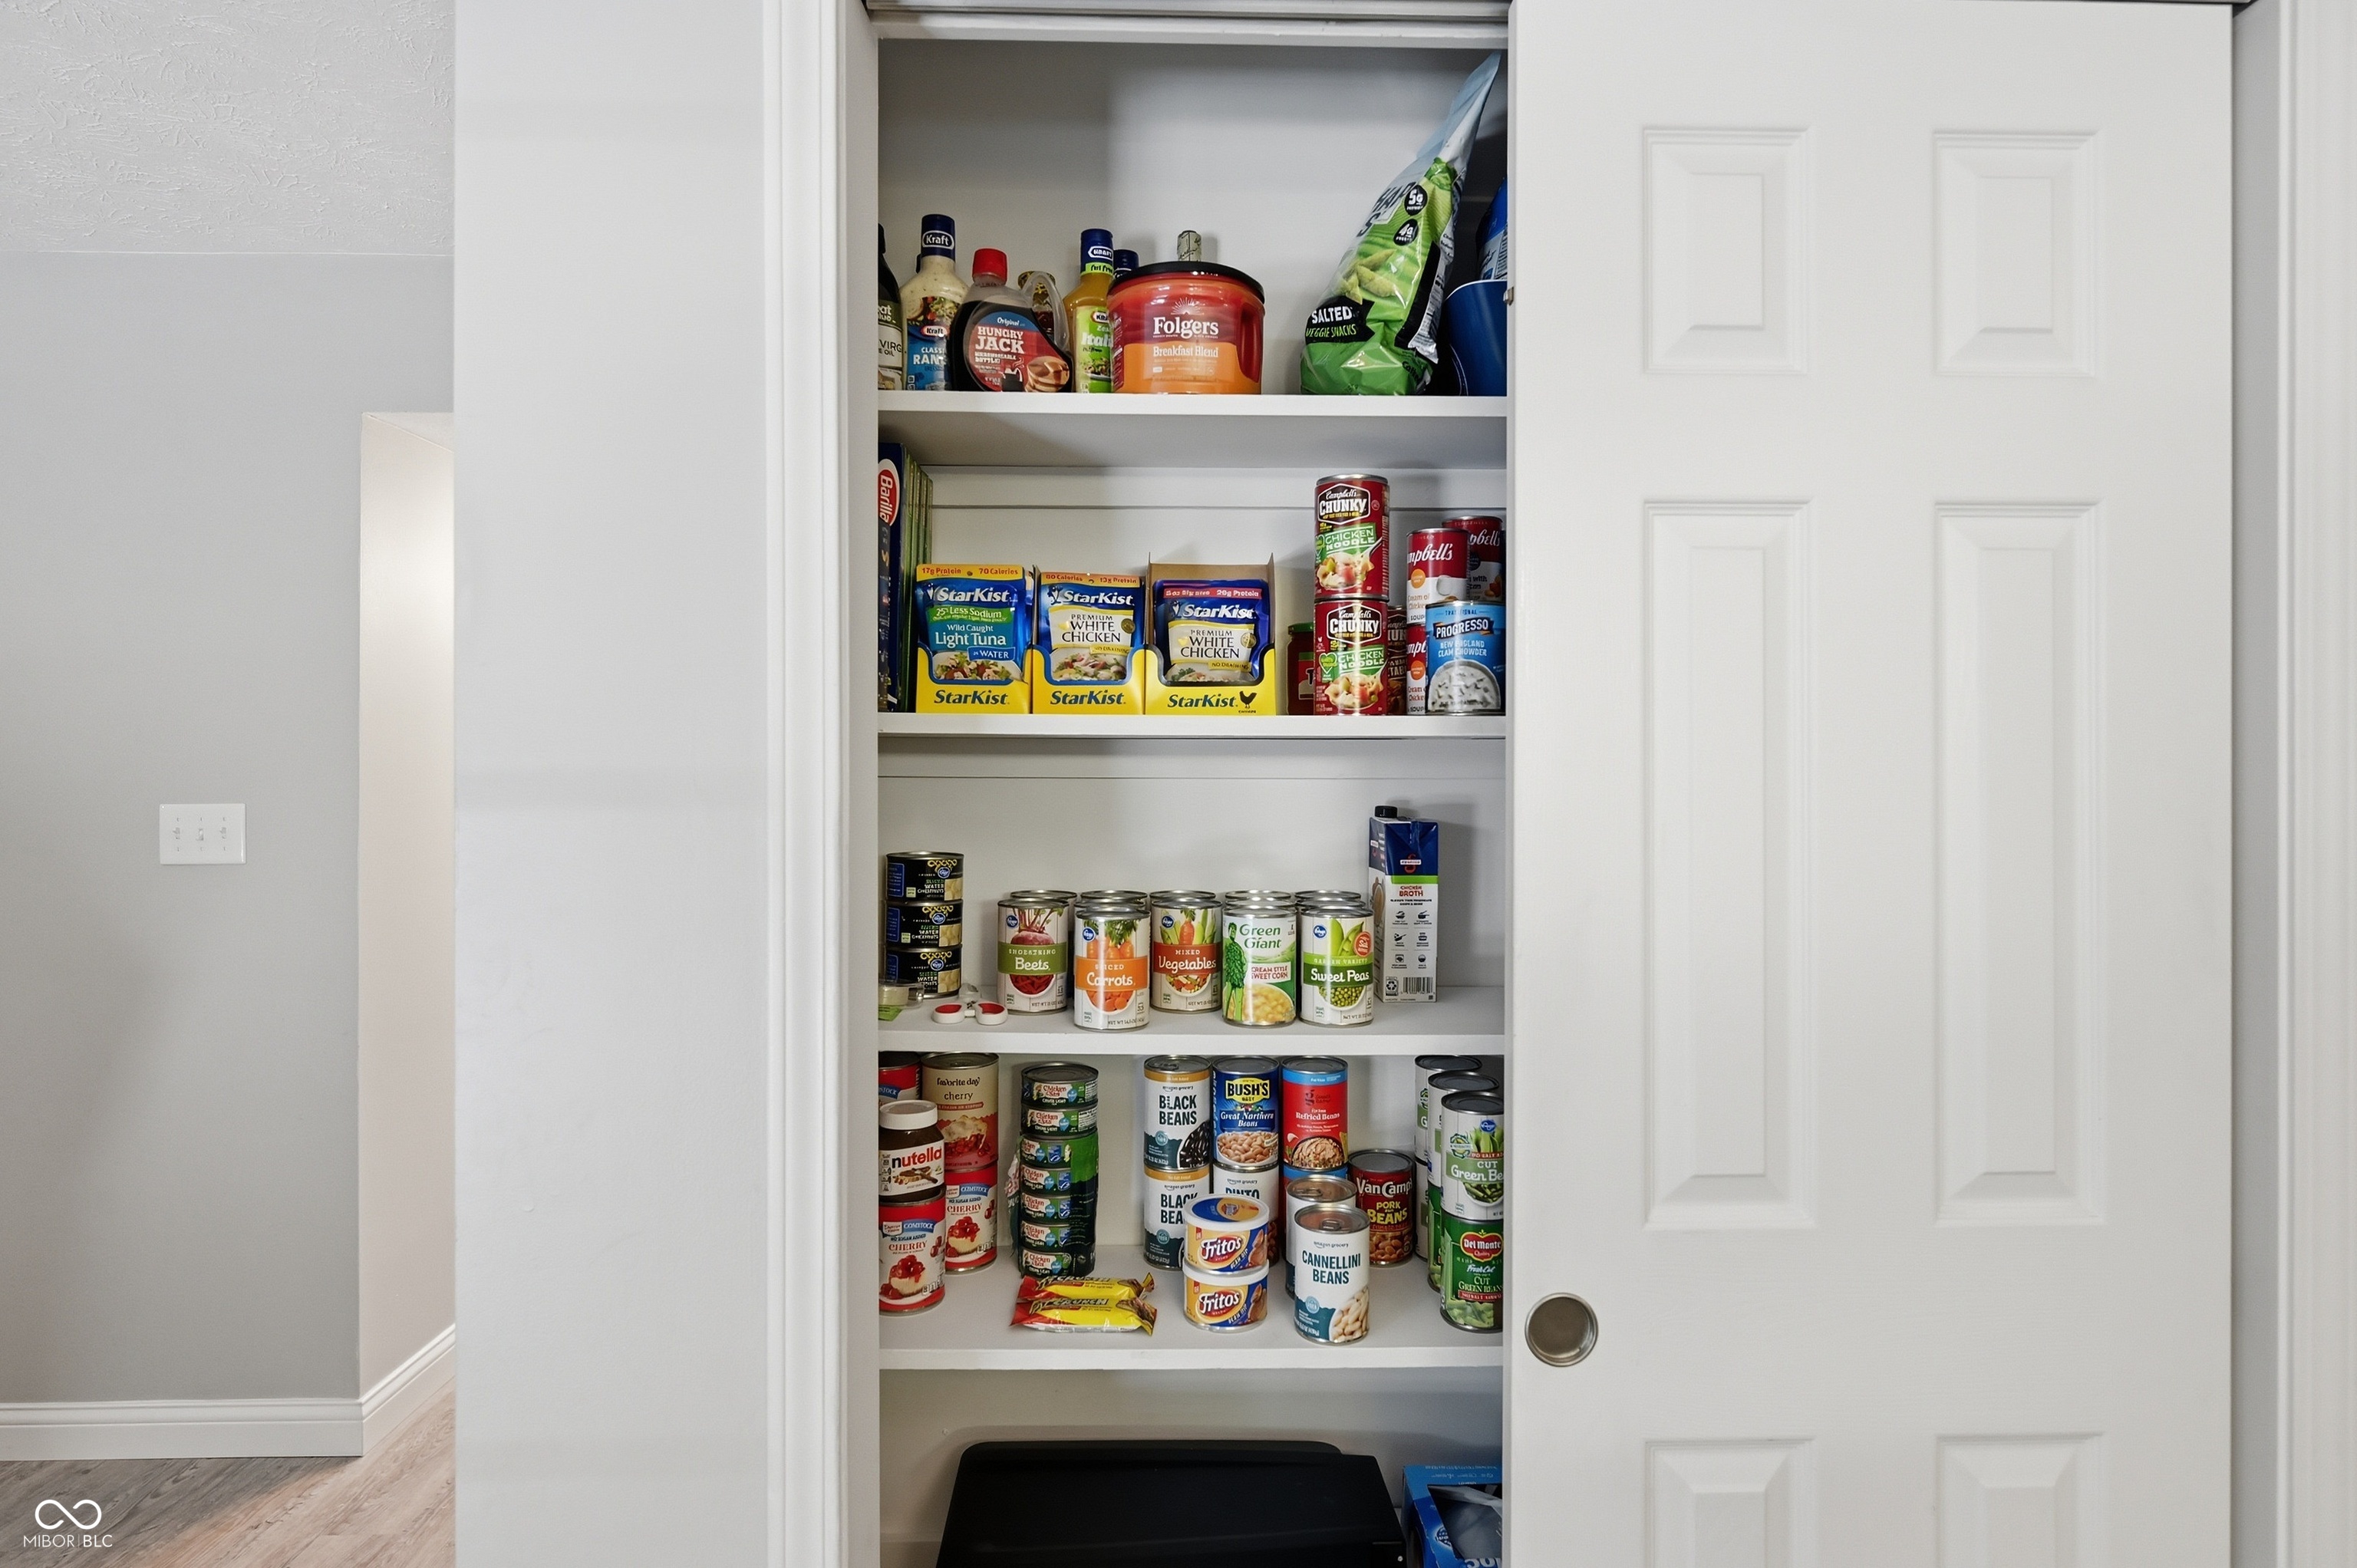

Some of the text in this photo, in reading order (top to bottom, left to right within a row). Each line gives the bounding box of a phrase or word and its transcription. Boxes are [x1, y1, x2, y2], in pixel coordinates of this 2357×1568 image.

[925, 234, 949, 246] Kraft
[997, 316, 1020, 327] Original
[1311, 306, 1353, 324] SALTED
[977, 325, 1024, 340] HUNGRY
[1153, 316, 1220, 339] Folgers
[1305, 328, 1330, 338] VEGGIE
[974, 336, 1025, 354] JACK
[1082, 331, 1113, 348] Itali
[1153, 345, 1218, 357] Breakfast Blend
[913, 354, 947, 365] RAN
[879, 475, 893, 522] Barilla
[1319, 499, 1366, 516] CHUNKY
[1326, 529, 1374, 545] CHICKEN
[1326, 537, 1376, 551] NOODLE
[937, 587, 1011, 602] StarKist
[1063, 590, 1135, 606] StarKist
[950, 605, 1002, 618] Less Sodium
[1182, 604, 1256, 619] StarKist
[966, 624, 994, 632] Caught
[1070, 621, 1115, 632] WHITE
[1330, 618, 1379, 634] CHUNKY
[1436, 619, 1488, 638] PROGRESSO
[935, 631, 1006, 649] Light Tuna
[1062, 632, 1121, 643] CHICKEN
[1190, 637, 1235, 648] WHITE
[980, 651, 1009, 659] WATER
[1181, 647, 1240, 658] CHICKEN
[1338, 651, 1384, 664] CHICKEN
[1439, 649, 1453, 657] CLAM
[1339, 659, 1384, 670] NOODLE
[934, 689, 1010, 704] StarKist
[1050, 690, 1126, 705] StarKist
[1167, 693, 1238, 707] StarKist
[1239, 924, 1281, 937] Green
[1244, 937, 1282, 949] Giant
[1015, 957, 1050, 970] Beets
[1159, 956, 1216, 974] Vegetables
[1086, 972, 1133, 987] Carrots
[1310, 967, 1370, 983] Sweet Peas
[937, 1077, 981, 1087] favorite day
[944, 1092, 973, 1101] cherry
[1228, 1083, 1268, 1097] BUSH'S
[1159, 1095, 1197, 1110] BLACK
[1159, 1112, 1197, 1126] BEANS
[1221, 1112, 1240, 1121] Great
[1296, 1112, 1340, 1121] Refried Beans
[892, 1146, 942, 1168] nutella
[1451, 1164, 1487, 1181] Green
[1356, 1178, 1380, 1194] Van
[947, 1203, 983, 1214] CHERRY
[1376, 1201, 1400, 1210] PORK
[1160, 1210, 1184, 1225] BEA
[1367, 1207, 1408, 1224] BEANS
[903, 1222, 935, 1230] COMSTOCK
[888, 1240, 928, 1252] CHERRY
[1201, 1236, 1242, 1260] Fritos
[1463, 1238, 1502, 1250] Del Monte
[1302, 1250, 1361, 1270] CANNELLINI
[1313, 1268, 1350, 1285] BEANS
[1474, 1276, 1491, 1286] CUT
[1459, 1281, 1483, 1293] GREEN
[1198, 1290, 1240, 1315] Fritos
